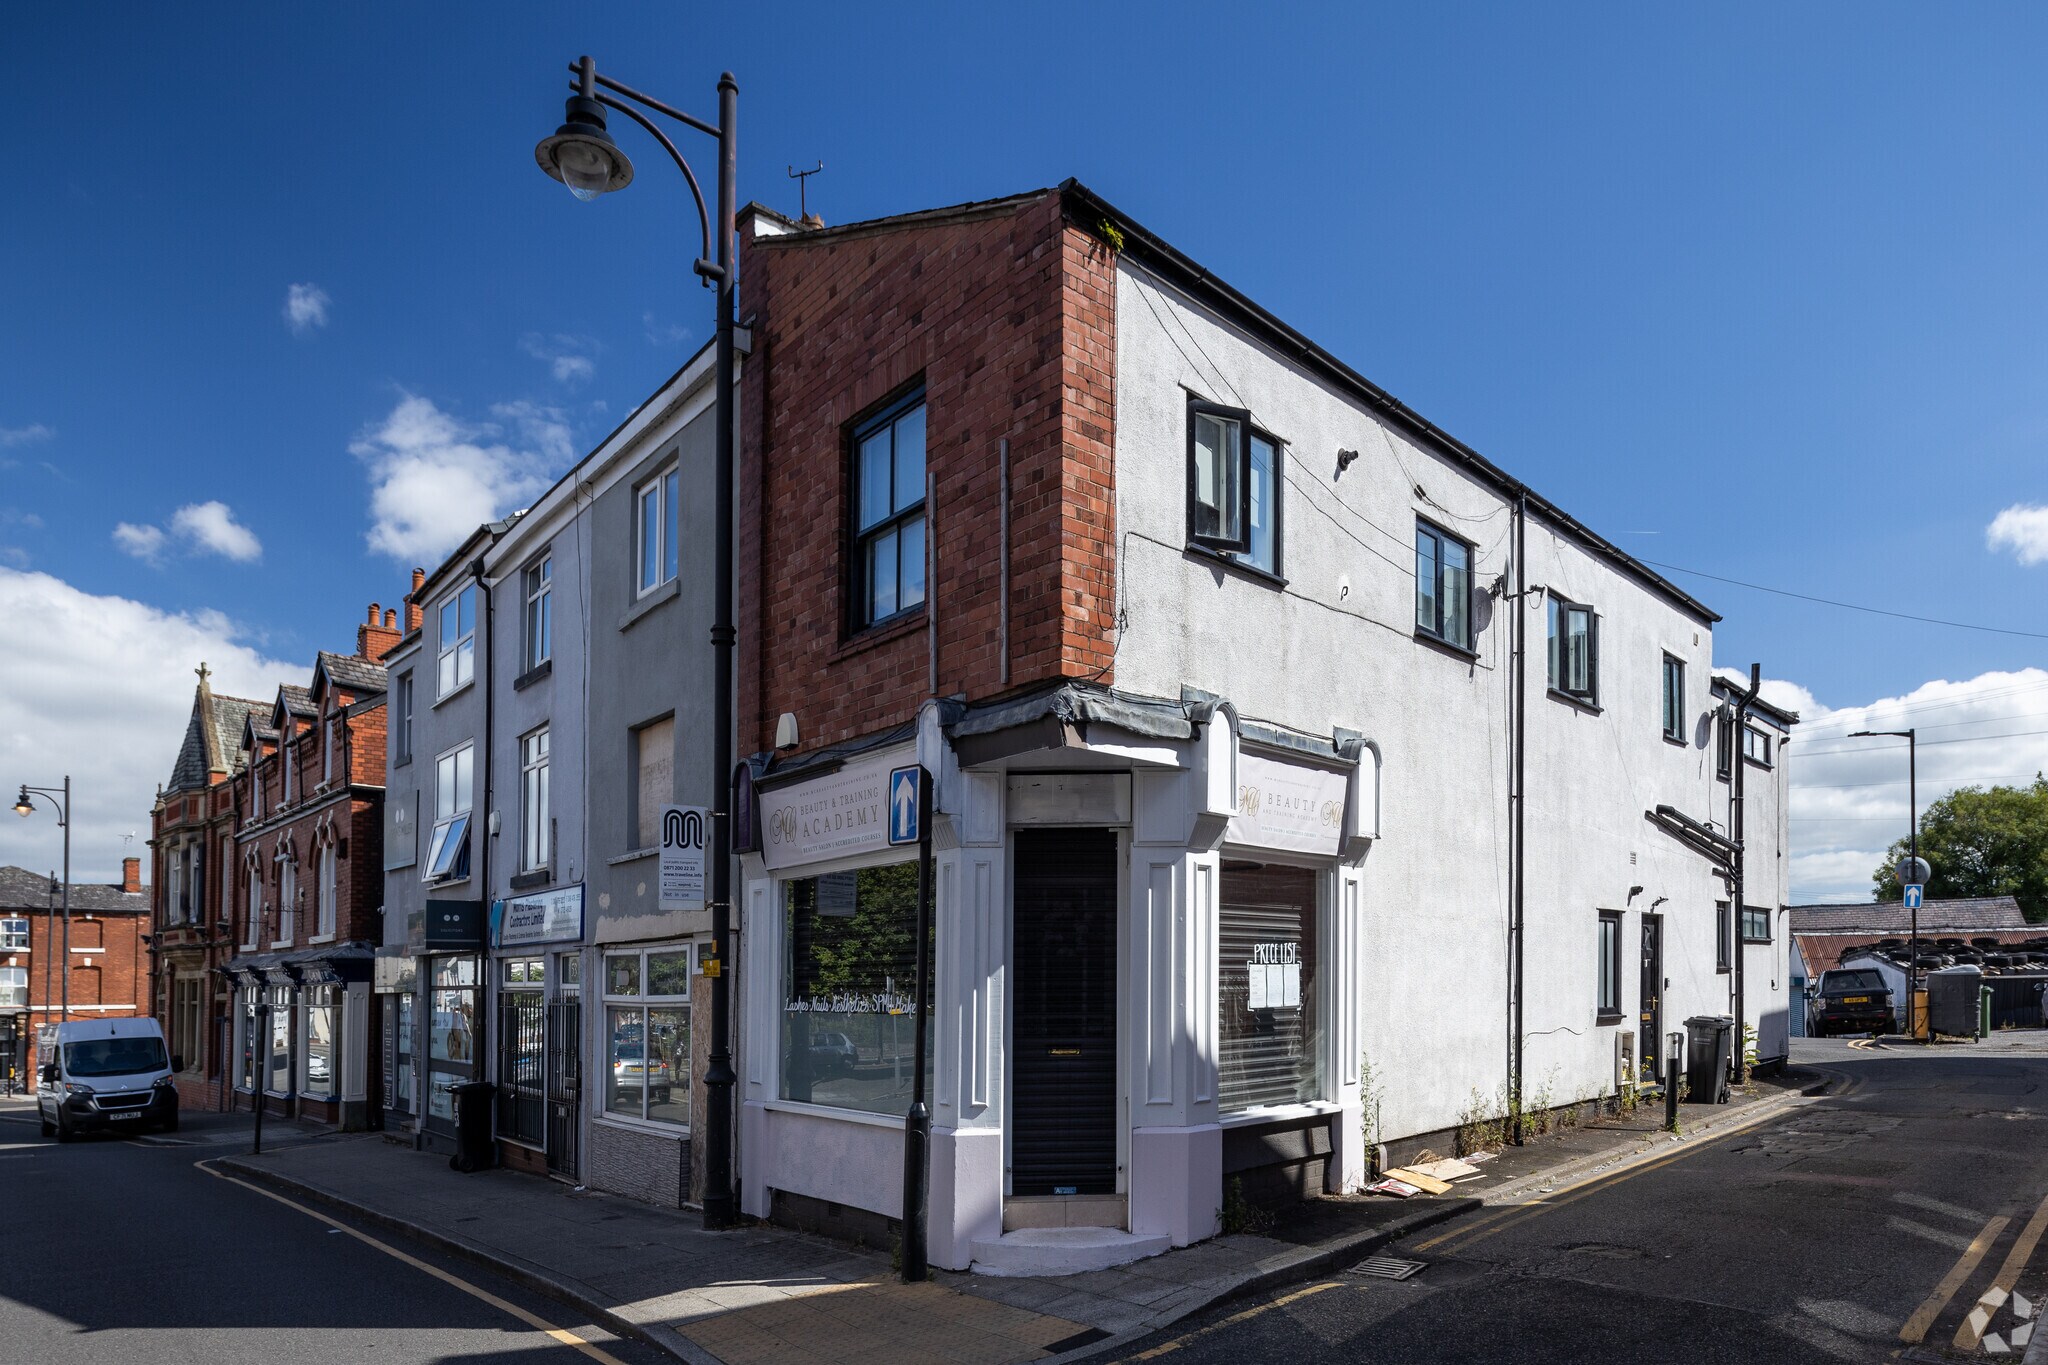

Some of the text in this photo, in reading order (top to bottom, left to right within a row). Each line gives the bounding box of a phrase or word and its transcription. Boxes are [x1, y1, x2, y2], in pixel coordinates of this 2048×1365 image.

[800, 786, 879, 816] BEAUTY & TRAINING
[1268, 792, 1316, 812] BEAUTY
[803, 804, 879, 838] ACADEMY
[835, 837, 861, 847] ACCREDITED
[1254, 942, 1297, 965] PRICE LIST
[784, 995, 809, 1014] Lashes
[810, 995, 829, 1013] Nails
[831, 992, 869, 1017] Aesthetics
[895, 994, 917, 1019] Make
